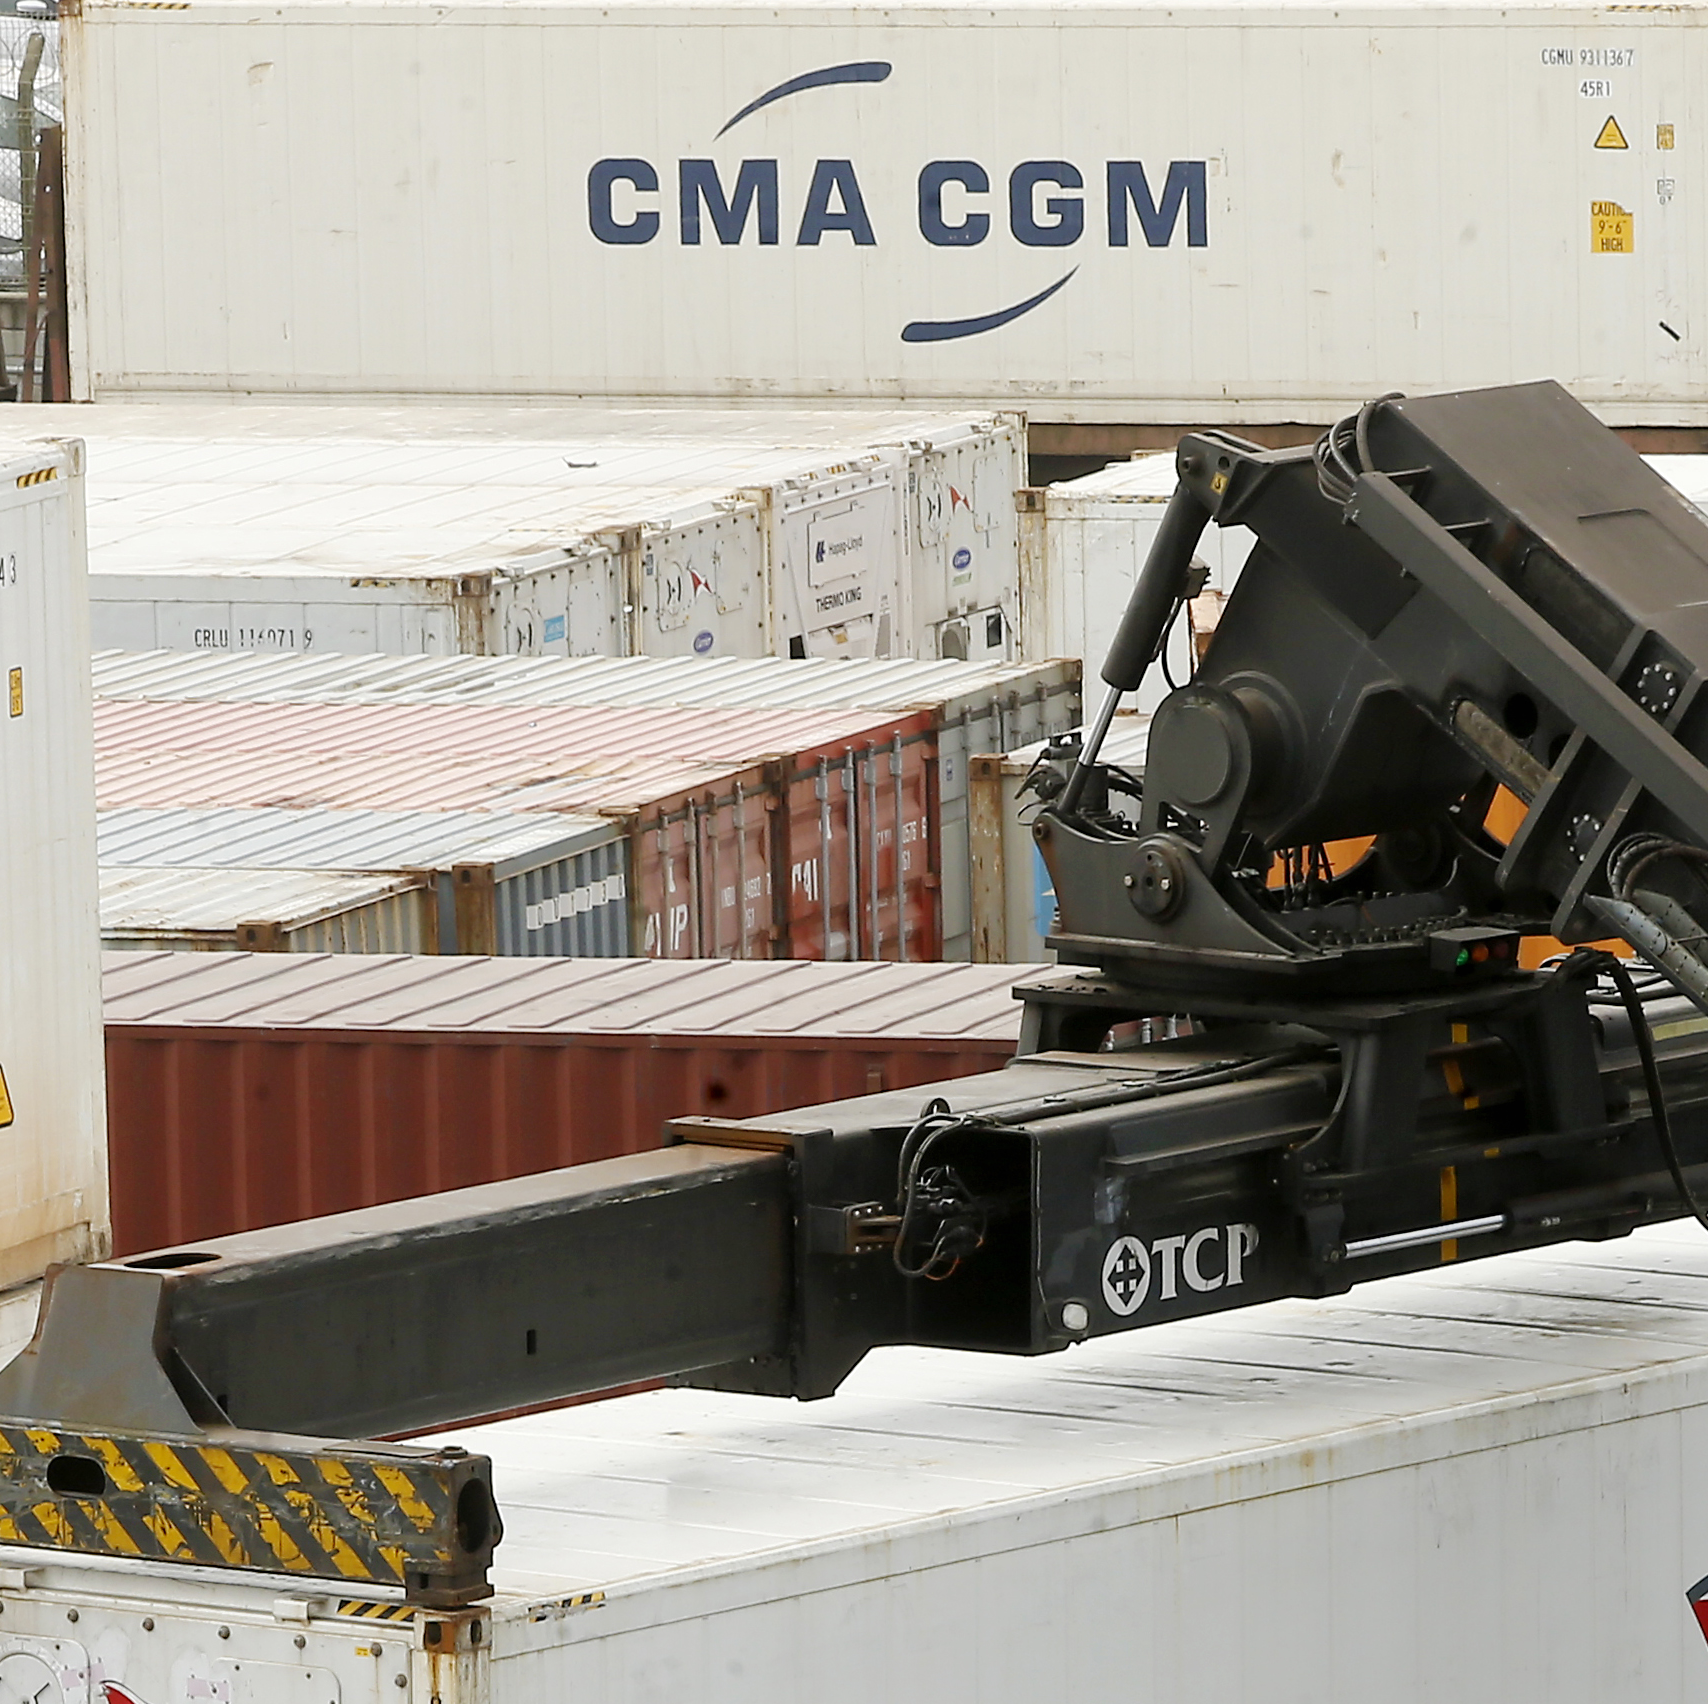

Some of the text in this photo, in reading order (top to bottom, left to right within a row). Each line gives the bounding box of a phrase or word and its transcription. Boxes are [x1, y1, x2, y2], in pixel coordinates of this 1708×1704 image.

[1541, 49, 1573, 66] CGMU
[1580, 80, 1612, 97] 45R1
[587, 157, 1209, 249] CMA CGM
[1600, 238, 1623, 252] HIGH
[194, 629, 228, 647] CRLU
[1150, 1222, 1260, 1301] TCP
